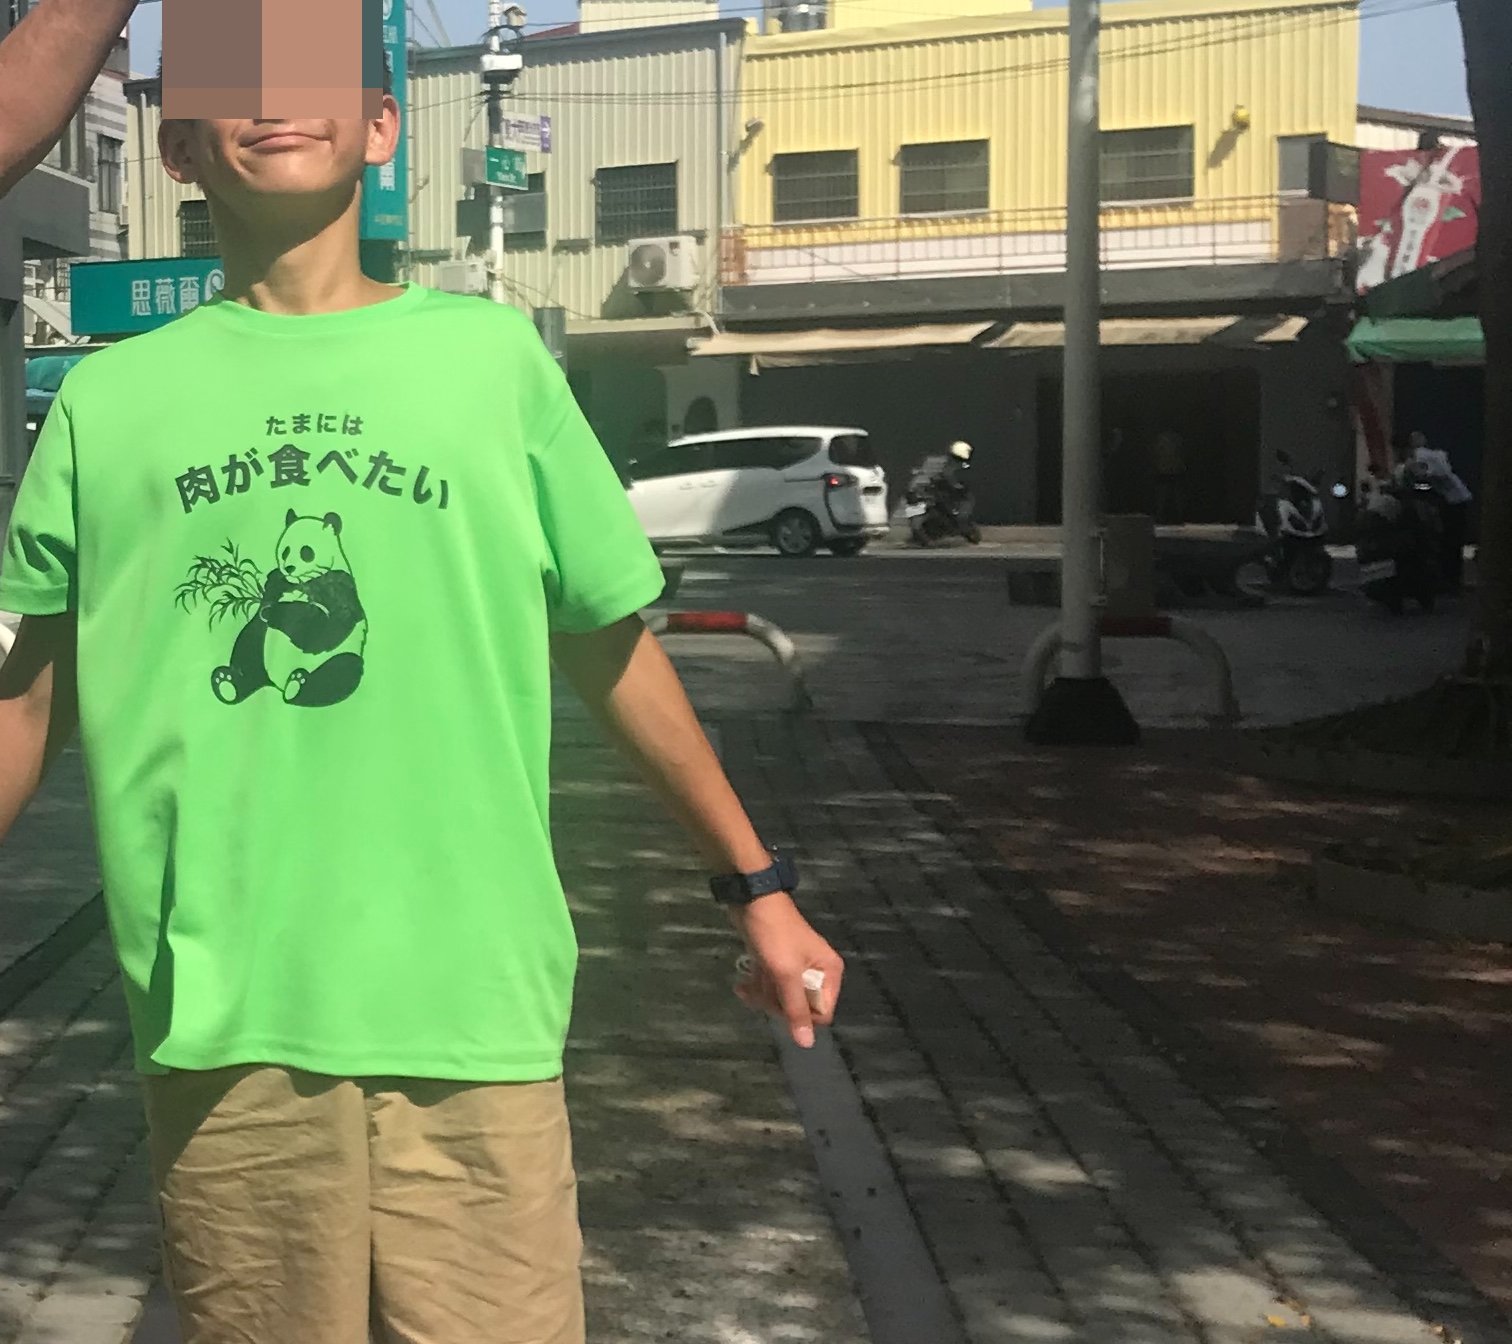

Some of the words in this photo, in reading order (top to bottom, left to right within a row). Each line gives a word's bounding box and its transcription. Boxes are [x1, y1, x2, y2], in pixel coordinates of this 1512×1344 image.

[131, 276, 200, 316] 思薇爾
[266, 413, 364, 436] たまには
[175, 443, 450, 514] 肉が食べたい
